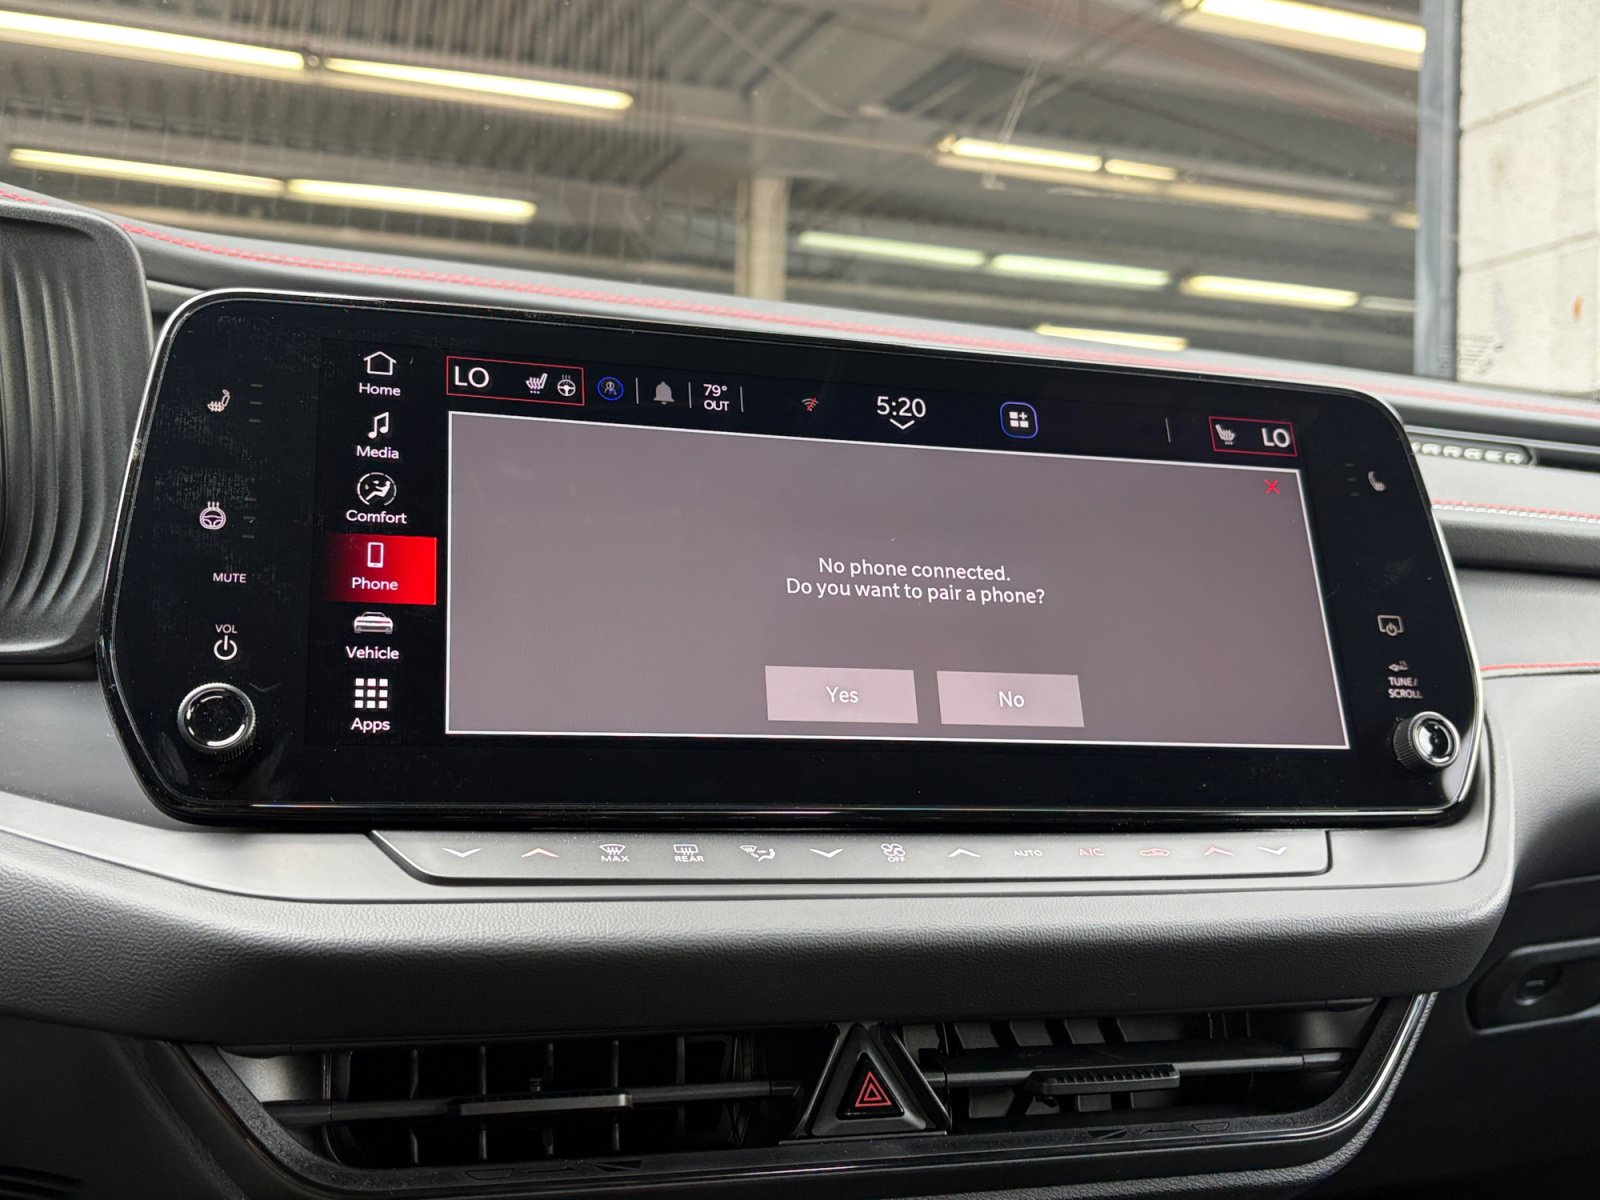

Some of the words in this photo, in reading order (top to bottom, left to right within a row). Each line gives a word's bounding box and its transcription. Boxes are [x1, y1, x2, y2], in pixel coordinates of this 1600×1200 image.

[453, 365, 490, 389] LO
[358, 382, 401, 397] Home
[703, 383, 728, 398] 79°
[703, 399, 730, 412] OUT
[876, 395, 927, 419] 5:20
[1261, 427, 1291, 449] LO
[356, 445, 400, 460] Media
[345, 509, 407, 525] Comfort
[818, 557, 845, 573] No
[849, 558, 908, 578] phone
[911, 563, 1012, 582] connected.
[212, 572, 247, 584] MUTE
[351, 576, 399, 591] Phone
[785, 577, 813, 594] Do
[816, 582, 851, 598] you
[854, 583, 901, 599] want
[904, 585, 923, 600] to
[927, 585, 962, 603] pair
[966, 588, 977, 601] a
[980, 587, 1046, 605] phone?
[215, 624, 238, 635] VOL
[345, 645, 400, 660] Vehicle
[825, 685, 859, 704] Yes
[998, 691, 1025, 708] No
[1387, 688, 1424, 699] SCROLL
[350, 717, 391, 733] Apps
[601, 854, 631, 863] MAX
[675, 854, 705, 863] REAR
[888, 855, 906, 863] OFF
[1013, 848, 1044, 858] AUTO
[1078, 846, 1105, 858] A/C
